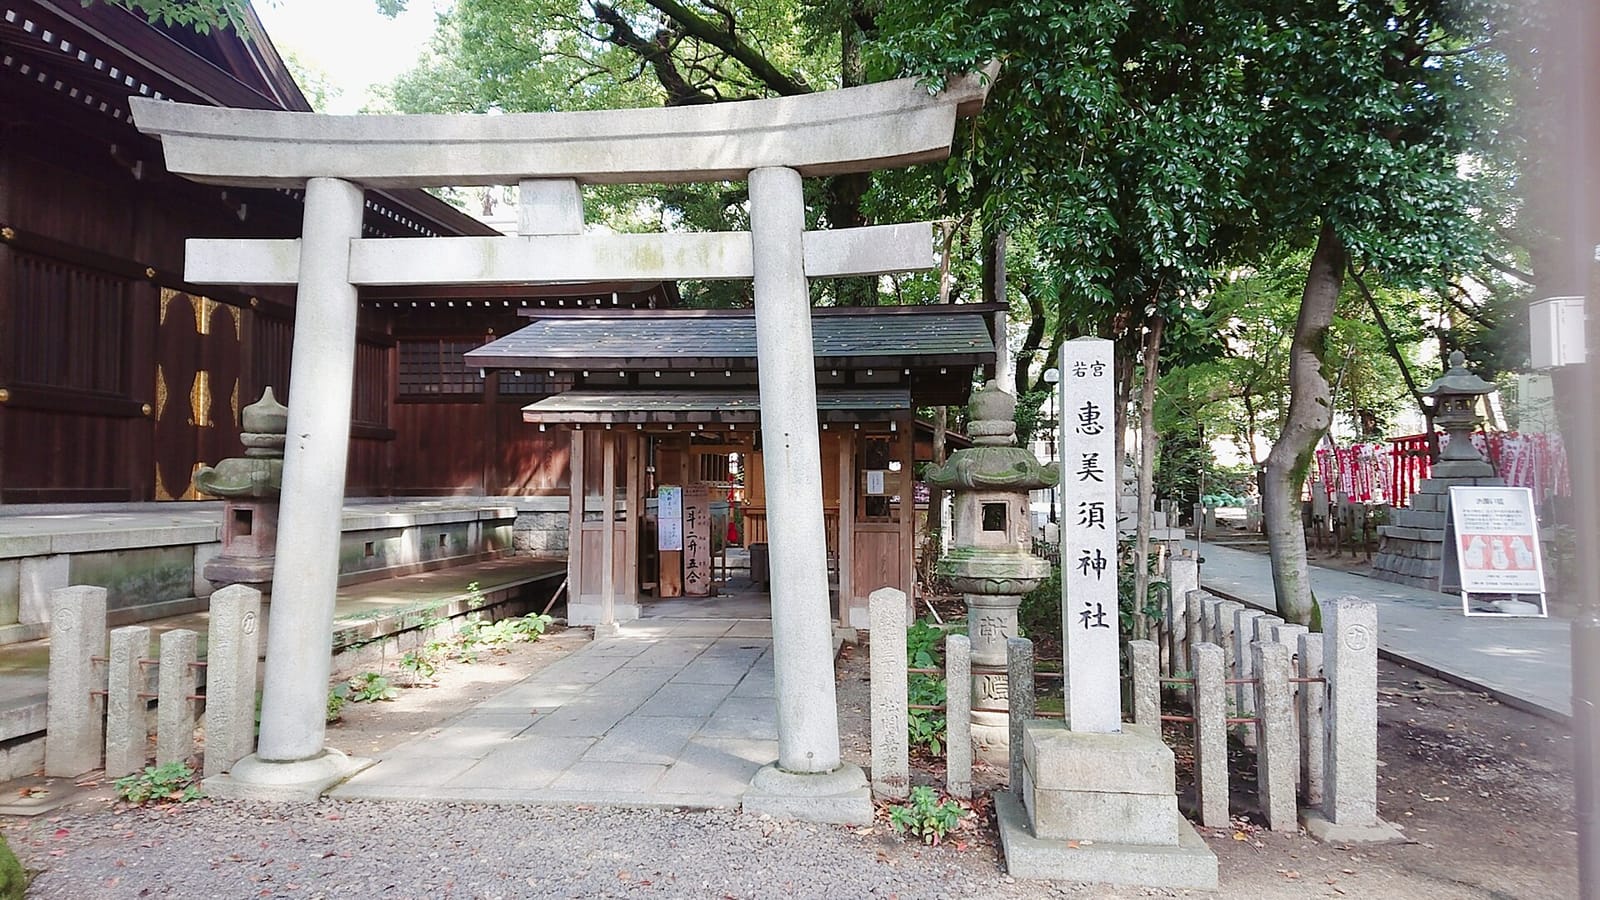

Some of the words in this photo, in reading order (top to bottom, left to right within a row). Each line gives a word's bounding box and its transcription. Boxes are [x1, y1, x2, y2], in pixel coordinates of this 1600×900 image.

[1072, 360, 1106, 378] 若宮
[686, 506, 700, 584] 一斗二升五合
